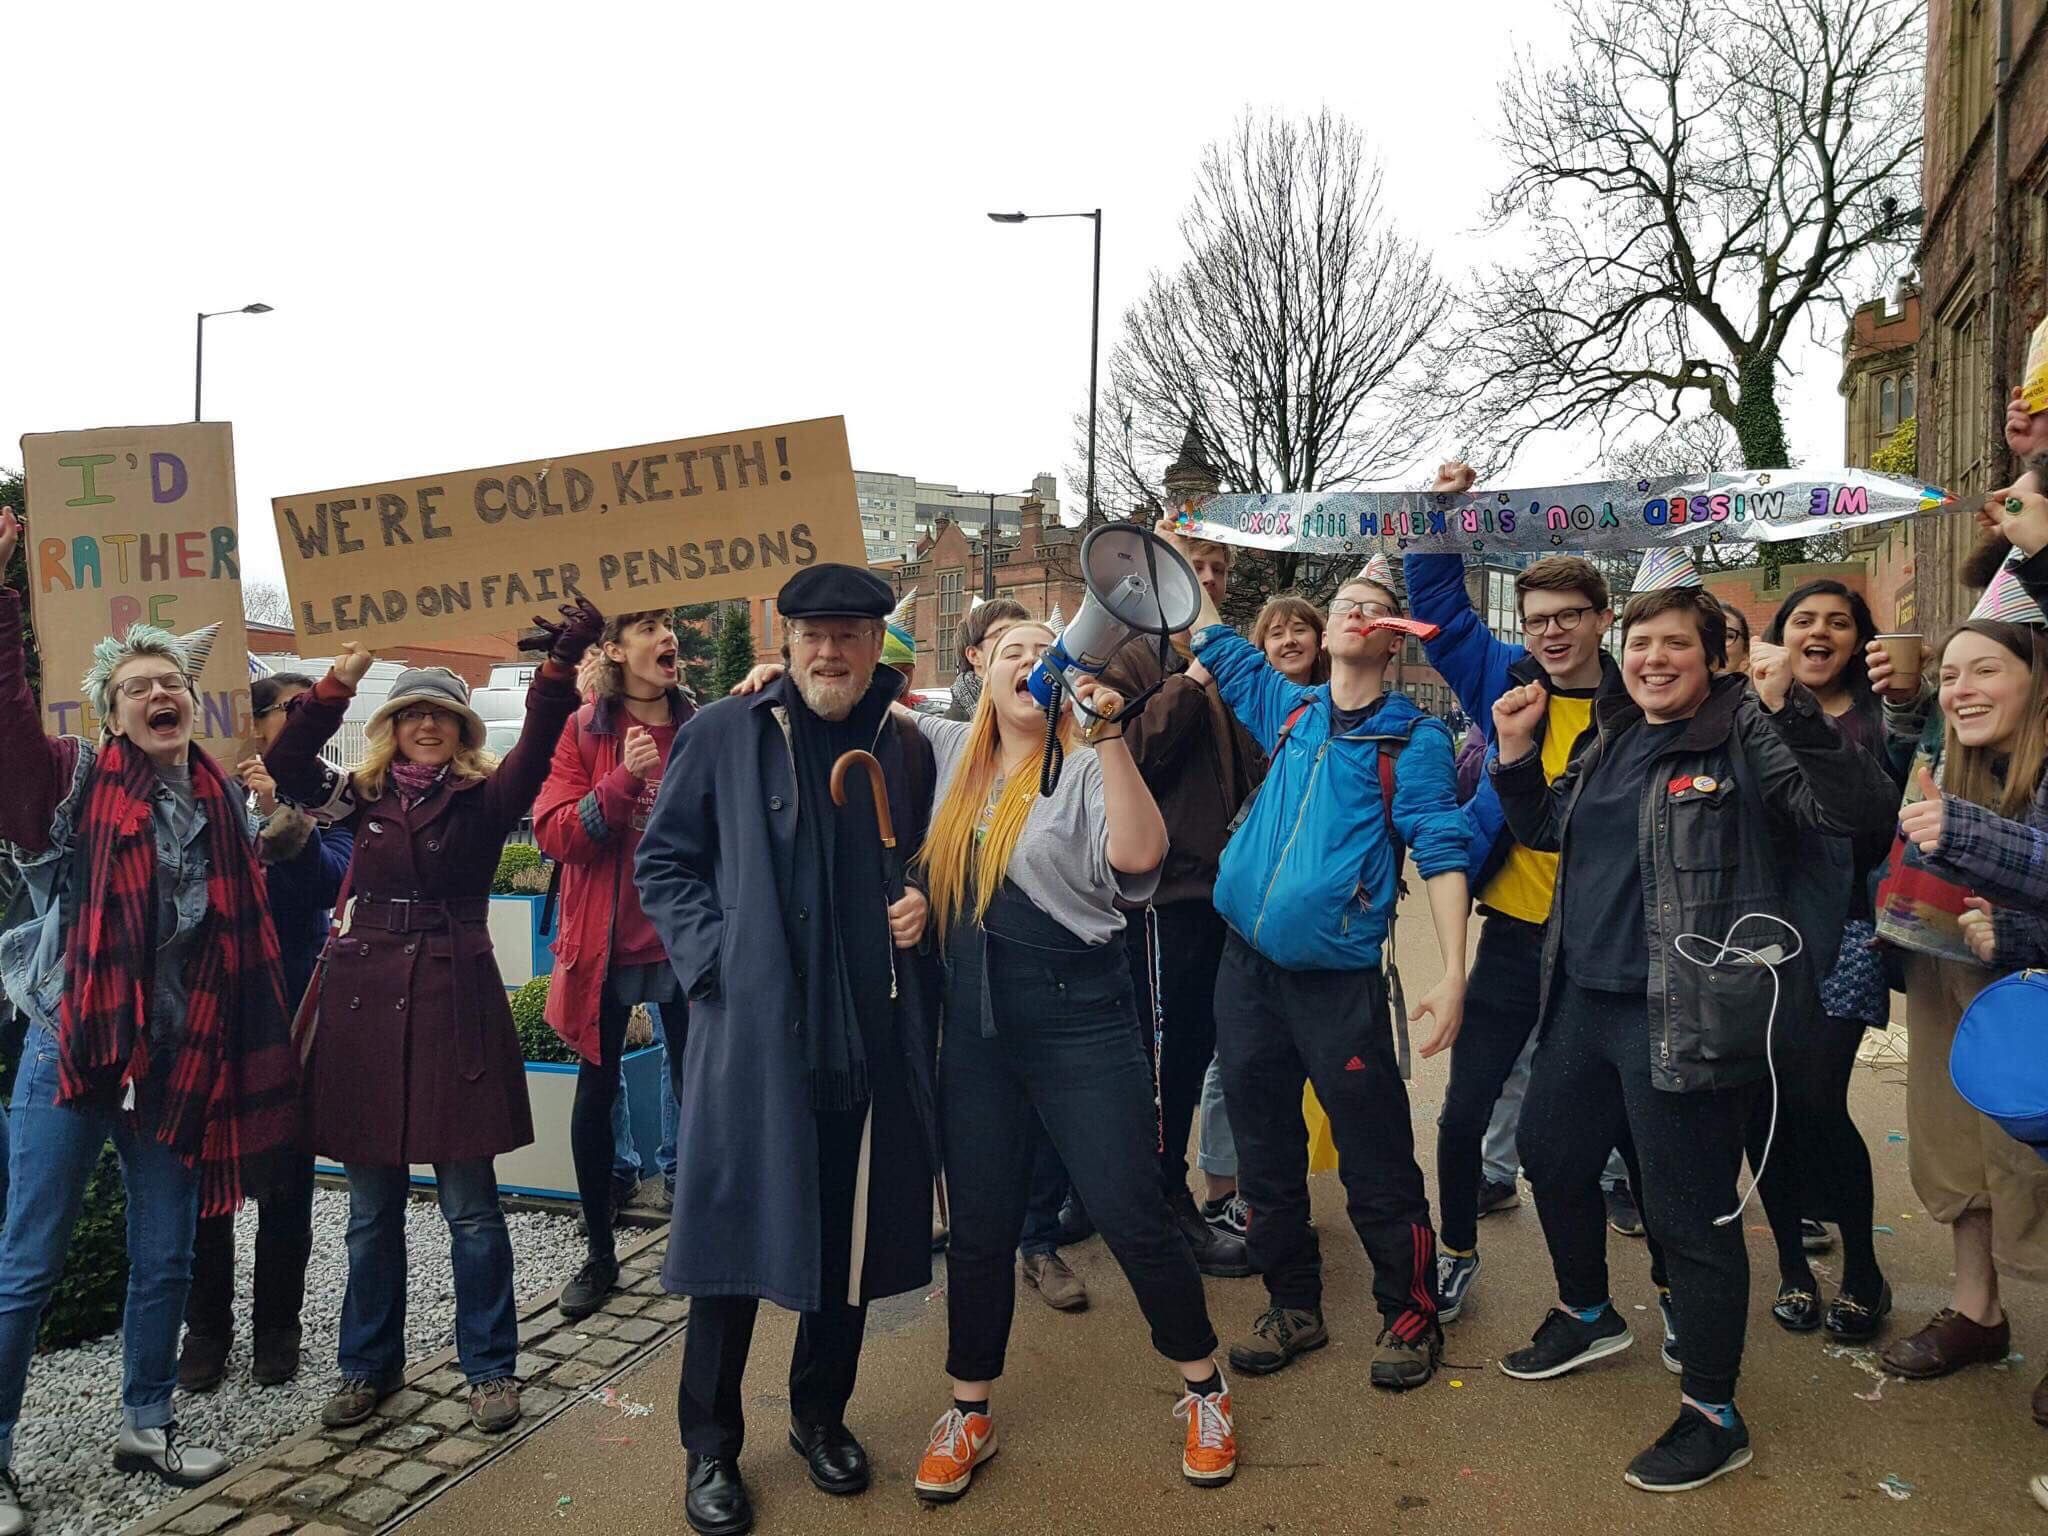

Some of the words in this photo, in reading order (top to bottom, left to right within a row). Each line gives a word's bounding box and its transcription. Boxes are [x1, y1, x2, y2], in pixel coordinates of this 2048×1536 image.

[58, 452, 188, 507] I'D
[284, 486, 453, 559] WE'RE
[474, 467, 608, 524] COLD,
[611, 437, 792, 505] KEITH!
[1808, 486, 1868, 516] WE
[1239, 511, 1290, 535] XOXO
[1360, 510, 1447, 537] KEITH
[1461, 509, 1516, 533] SIR
[1530, 501, 1619, 530] YOU,
[38, 526, 240, 593] RATHER
[302, 590, 408, 635] LEAD
[416, 581, 472, 617] ON
[480, 562, 585, 609] FAIR
[599, 523, 818, 591] PENSIONS
